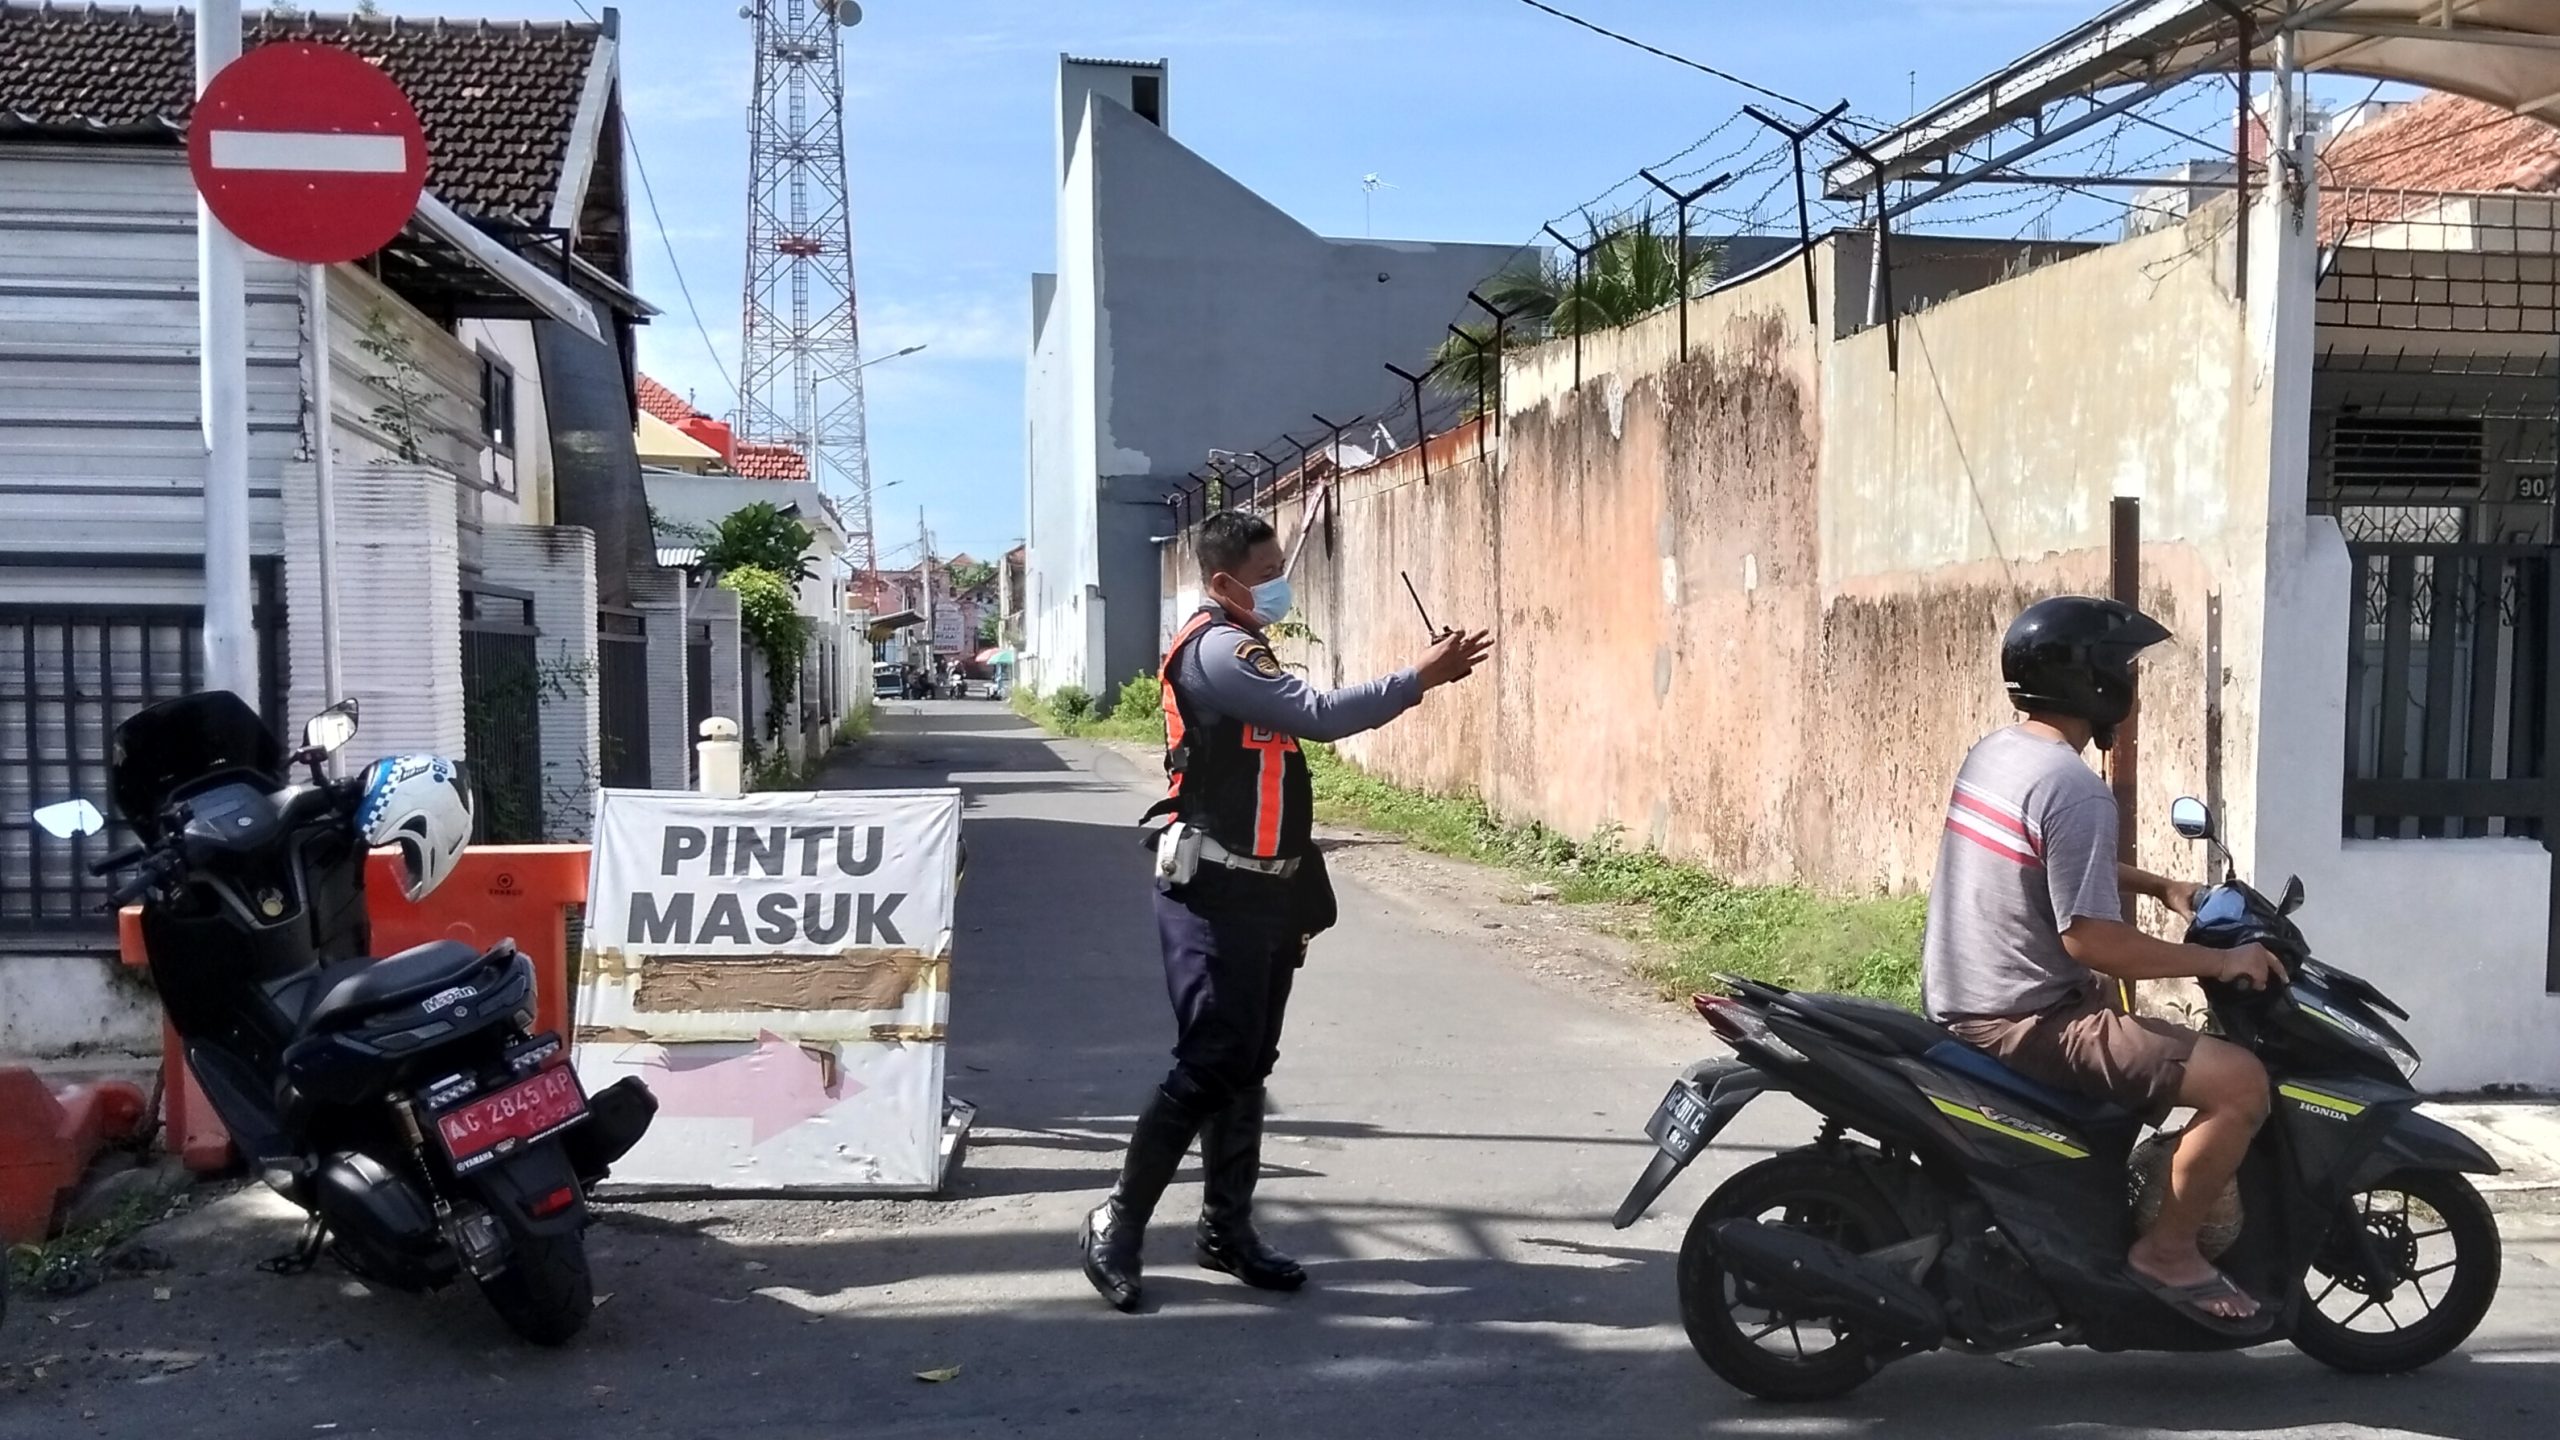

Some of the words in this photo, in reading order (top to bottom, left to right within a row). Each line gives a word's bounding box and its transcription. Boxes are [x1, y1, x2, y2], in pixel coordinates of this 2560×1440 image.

[2520, 478, 2545, 497] 30
[660, 825, 885, 877] PINTU
[626, 892, 908, 945] MASUK
[423, 986, 477, 1012] Mapan
[449, 1112, 481, 1140] AG
[487, 1084, 541, 1124] 2845
[544, 1072, 569, 1099] AP
[2299, 1102, 2348, 1121] HONDA
[464, 1150, 495, 1169] YAMAHA
